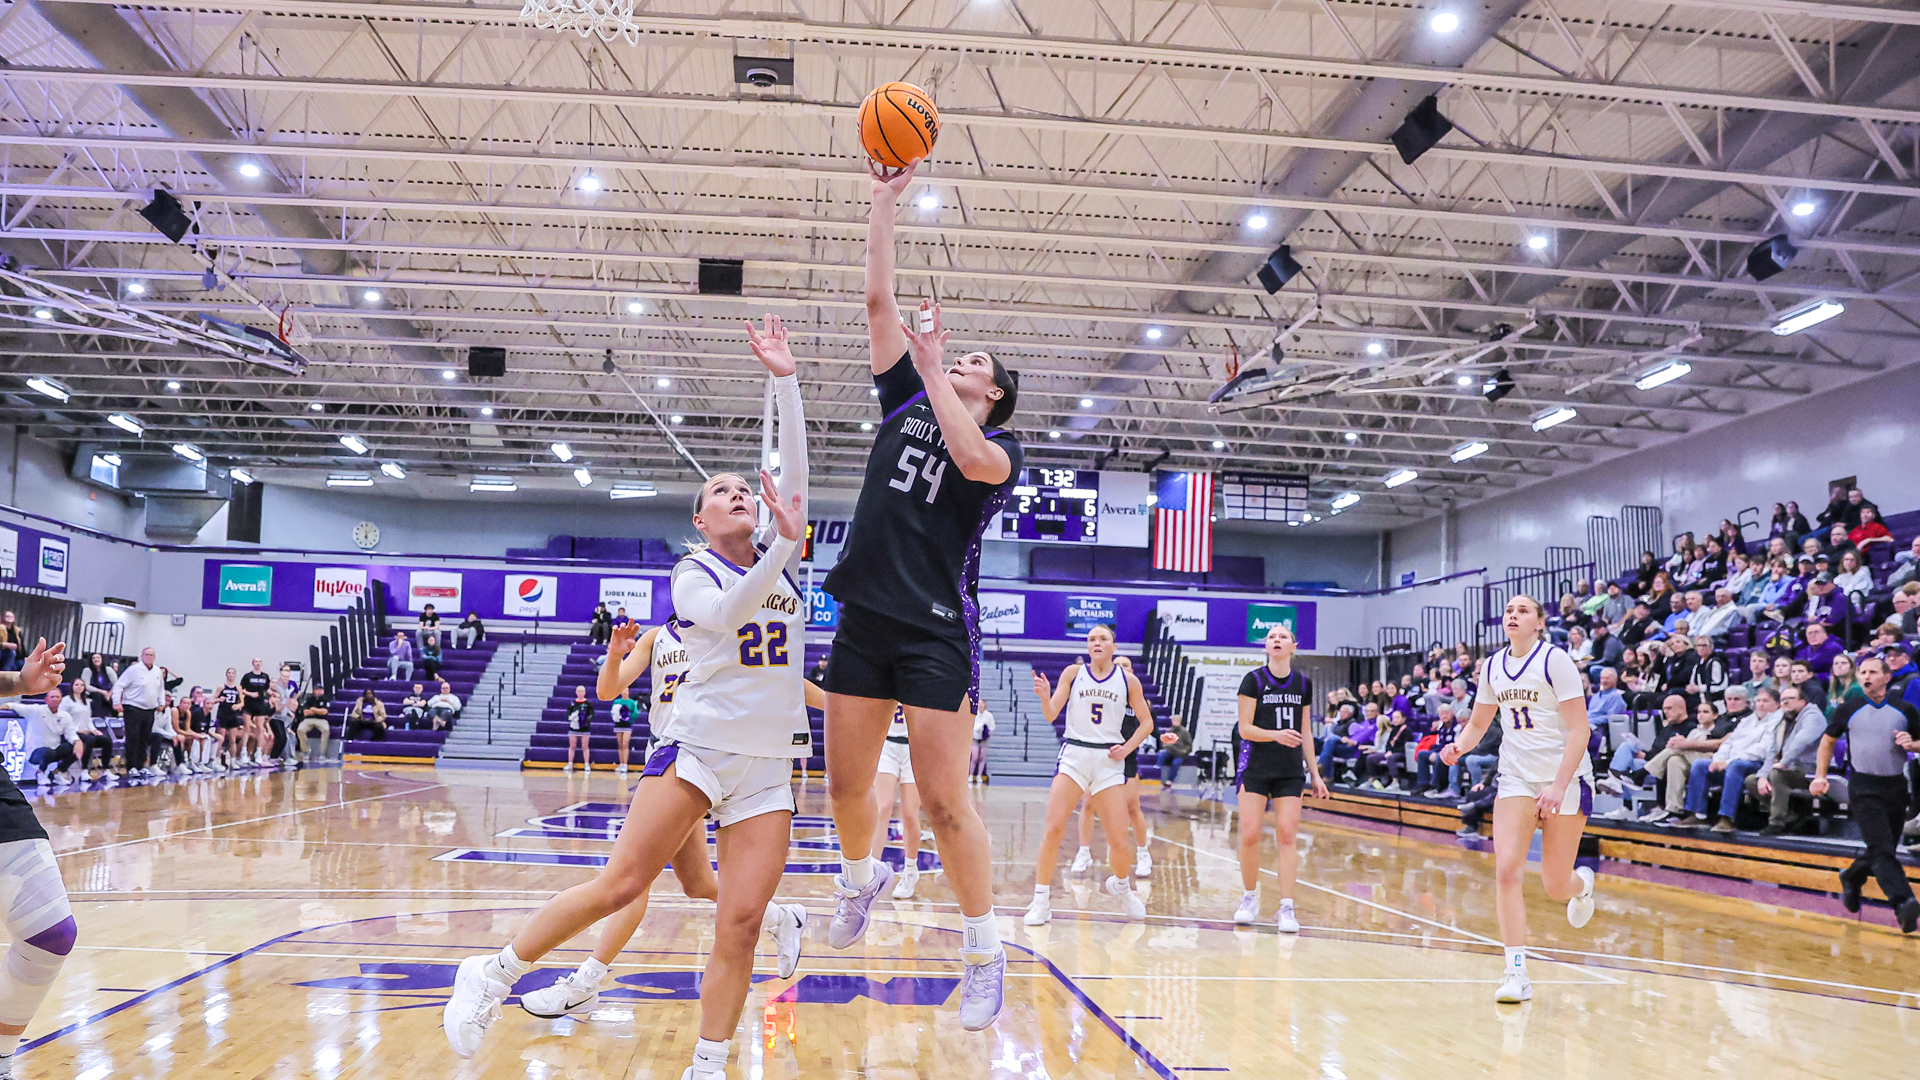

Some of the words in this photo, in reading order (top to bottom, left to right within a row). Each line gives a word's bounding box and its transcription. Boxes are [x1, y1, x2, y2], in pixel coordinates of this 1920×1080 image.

[905, 97, 939, 147] Wilson
[900, 416, 938, 444] SIOUX
[888, 445, 947, 504] 54
[1039, 468, 1075, 488] 7:32
[1018, 495, 1031, 514] 2
[1050, 499, 1056, 512] 1
[1084, 498, 1097, 517] 6
[1101, 502, 1136, 515] Avera
[1012, 518, 1018, 532] 1
[1085, 521, 1096, 536] 2
[224, 579, 257, 592] Avera
[979, 603, 1020, 622] Culver's
[736, 620, 789, 668] 22
[225, 694, 237, 704] 23
[1079, 688, 1119, 703] MAVERICKS
[1262, 693, 1283, 704] SIOUX
[1284, 693, 1303, 705] FALLS
[1091, 702, 1104, 725] 5
[1274, 706, 1294, 729] 14
[1510, 705, 1534, 730] 11
